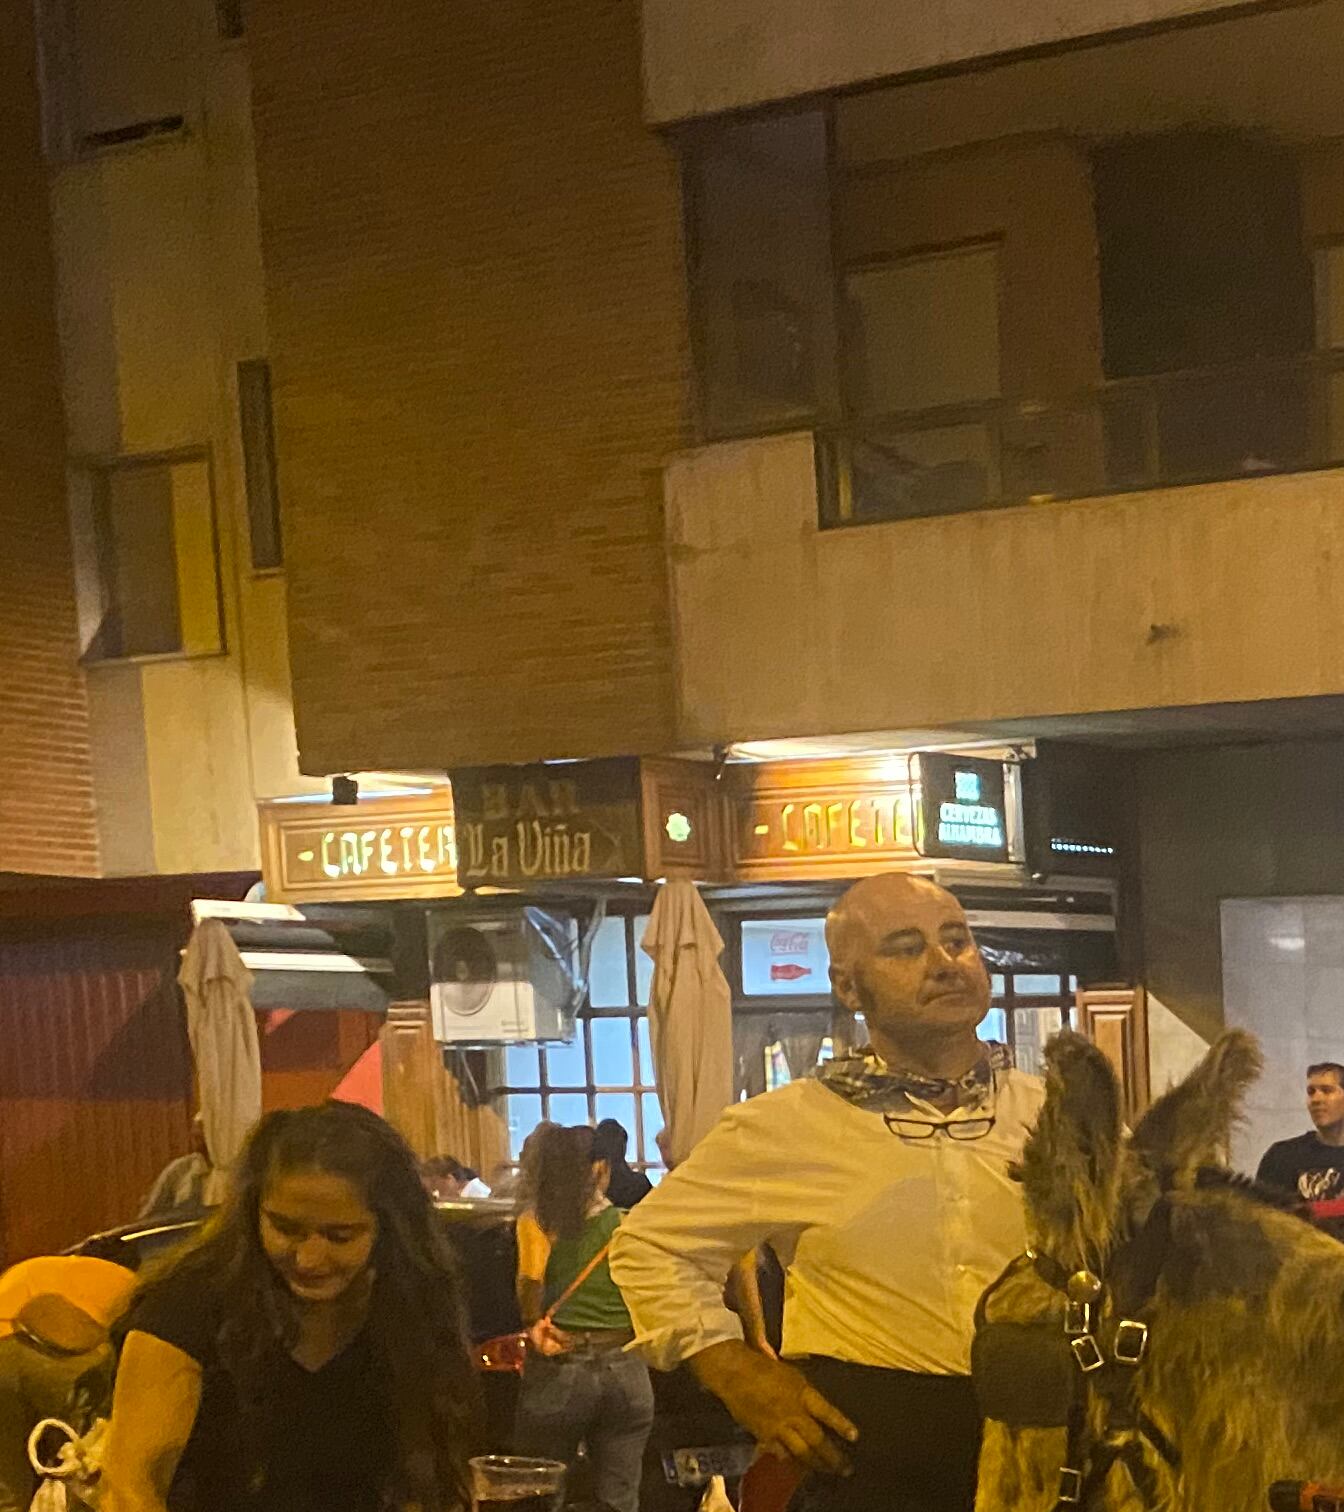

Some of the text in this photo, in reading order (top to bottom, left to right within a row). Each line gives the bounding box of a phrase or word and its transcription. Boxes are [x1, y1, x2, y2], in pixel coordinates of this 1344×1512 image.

[321, 825, 458, 879] CAFETER
[465, 819, 592, 878] La Viña
[782, 799, 924, 851] CAFETE
